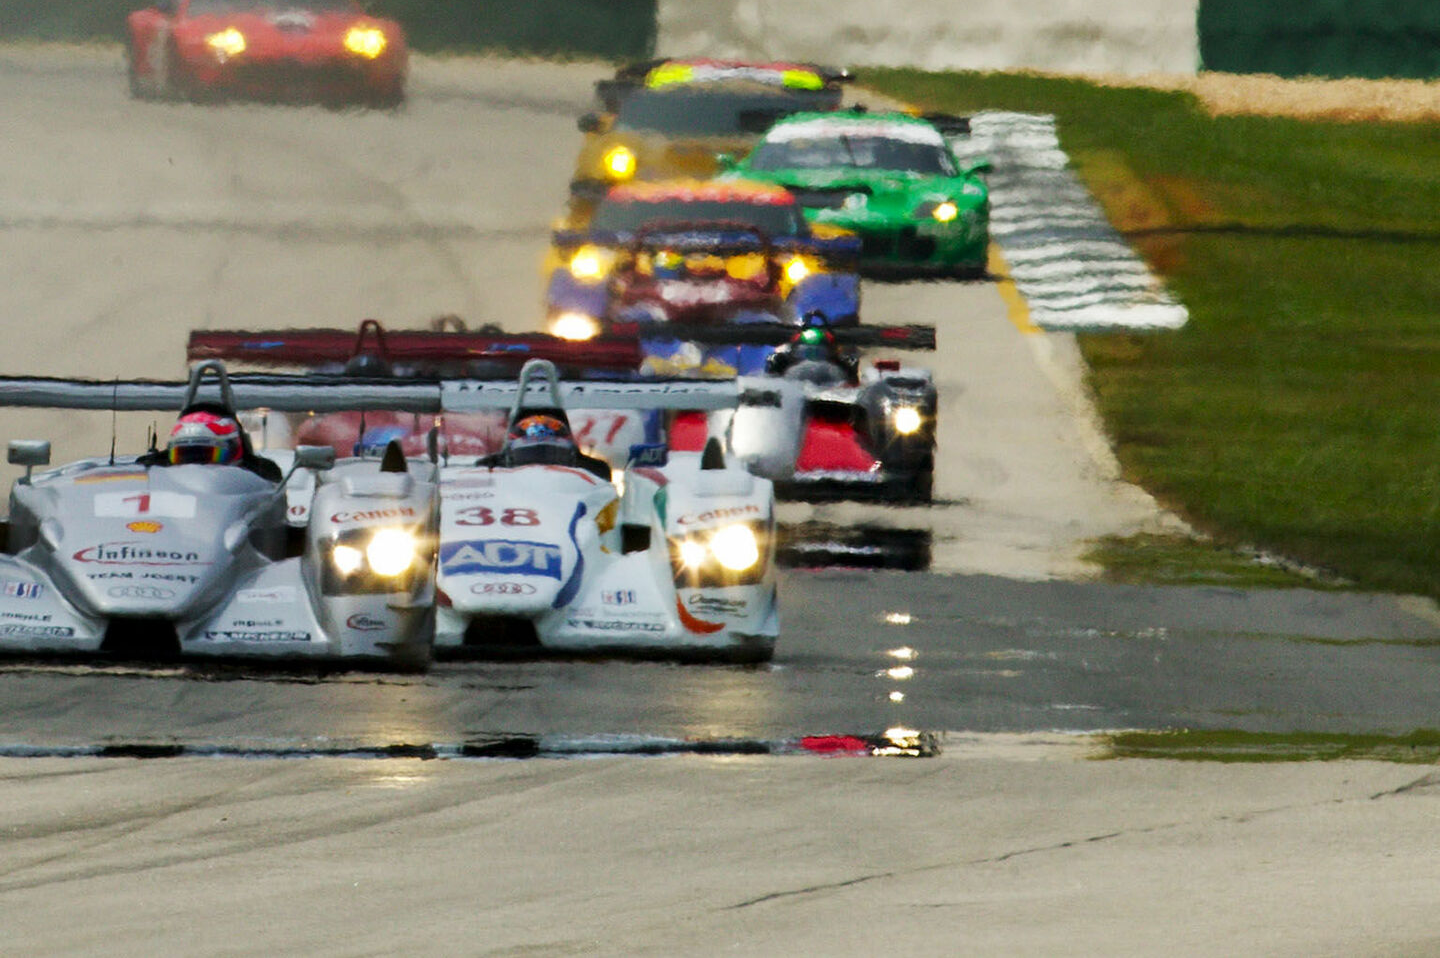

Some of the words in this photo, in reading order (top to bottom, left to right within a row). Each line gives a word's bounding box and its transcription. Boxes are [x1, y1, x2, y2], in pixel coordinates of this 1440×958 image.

[122, 494, 150, 514] 1
[329, 506, 415, 524] Canon
[455, 506, 541, 527] 38
[675, 504, 760, 525] Canon
[97, 543, 199, 560] infineon
[442, 542, 561, 571] ADT
